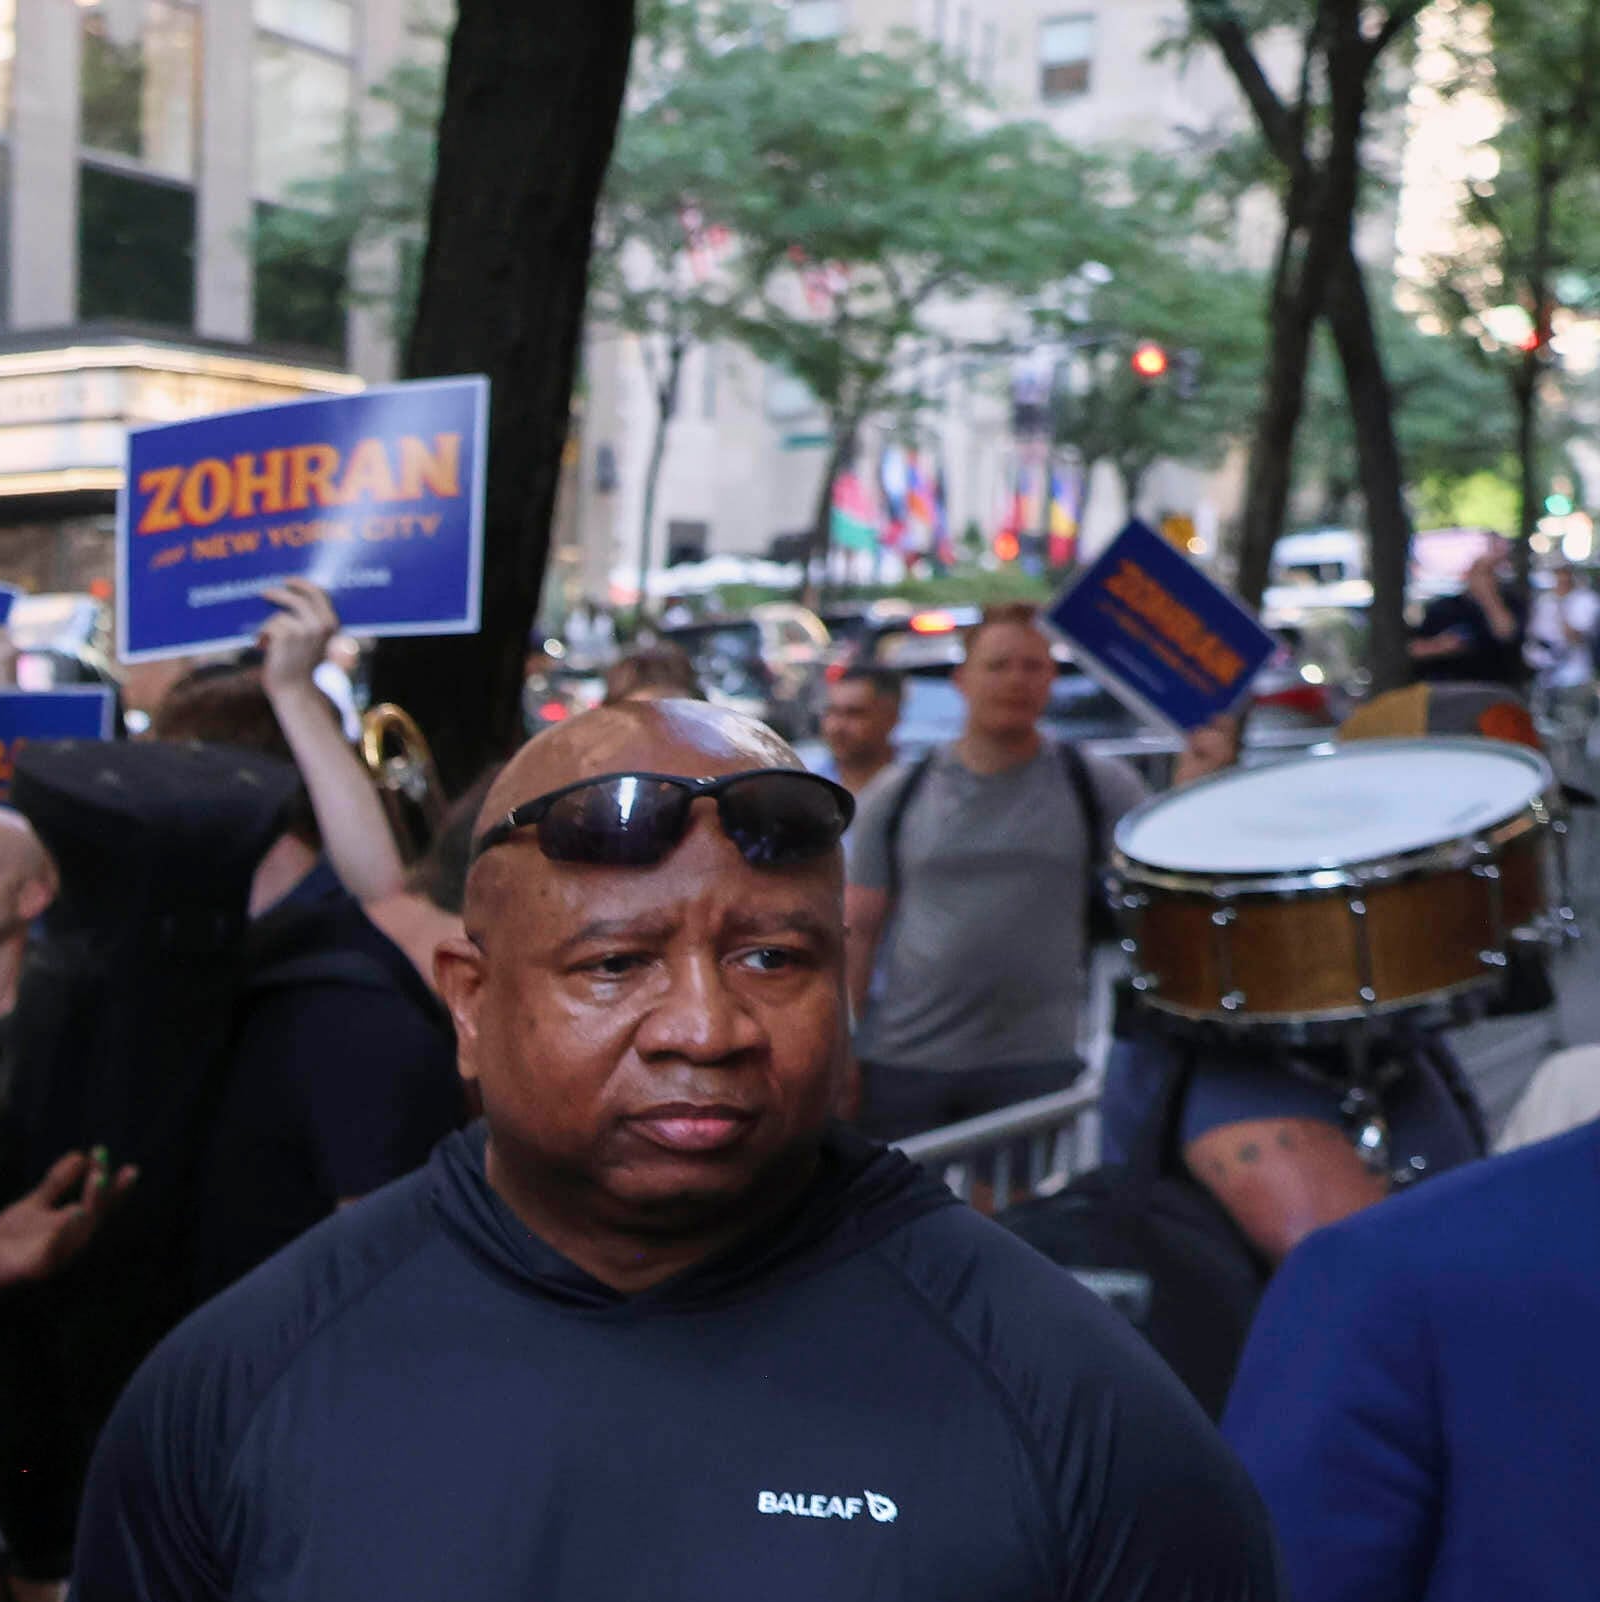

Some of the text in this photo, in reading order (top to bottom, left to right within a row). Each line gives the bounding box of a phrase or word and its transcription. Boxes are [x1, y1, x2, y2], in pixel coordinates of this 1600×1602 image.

[137, 432, 462, 535] ZOHRAN
[191, 531, 261, 561] NEW
[757, 1491, 864, 1520] BALEAF
